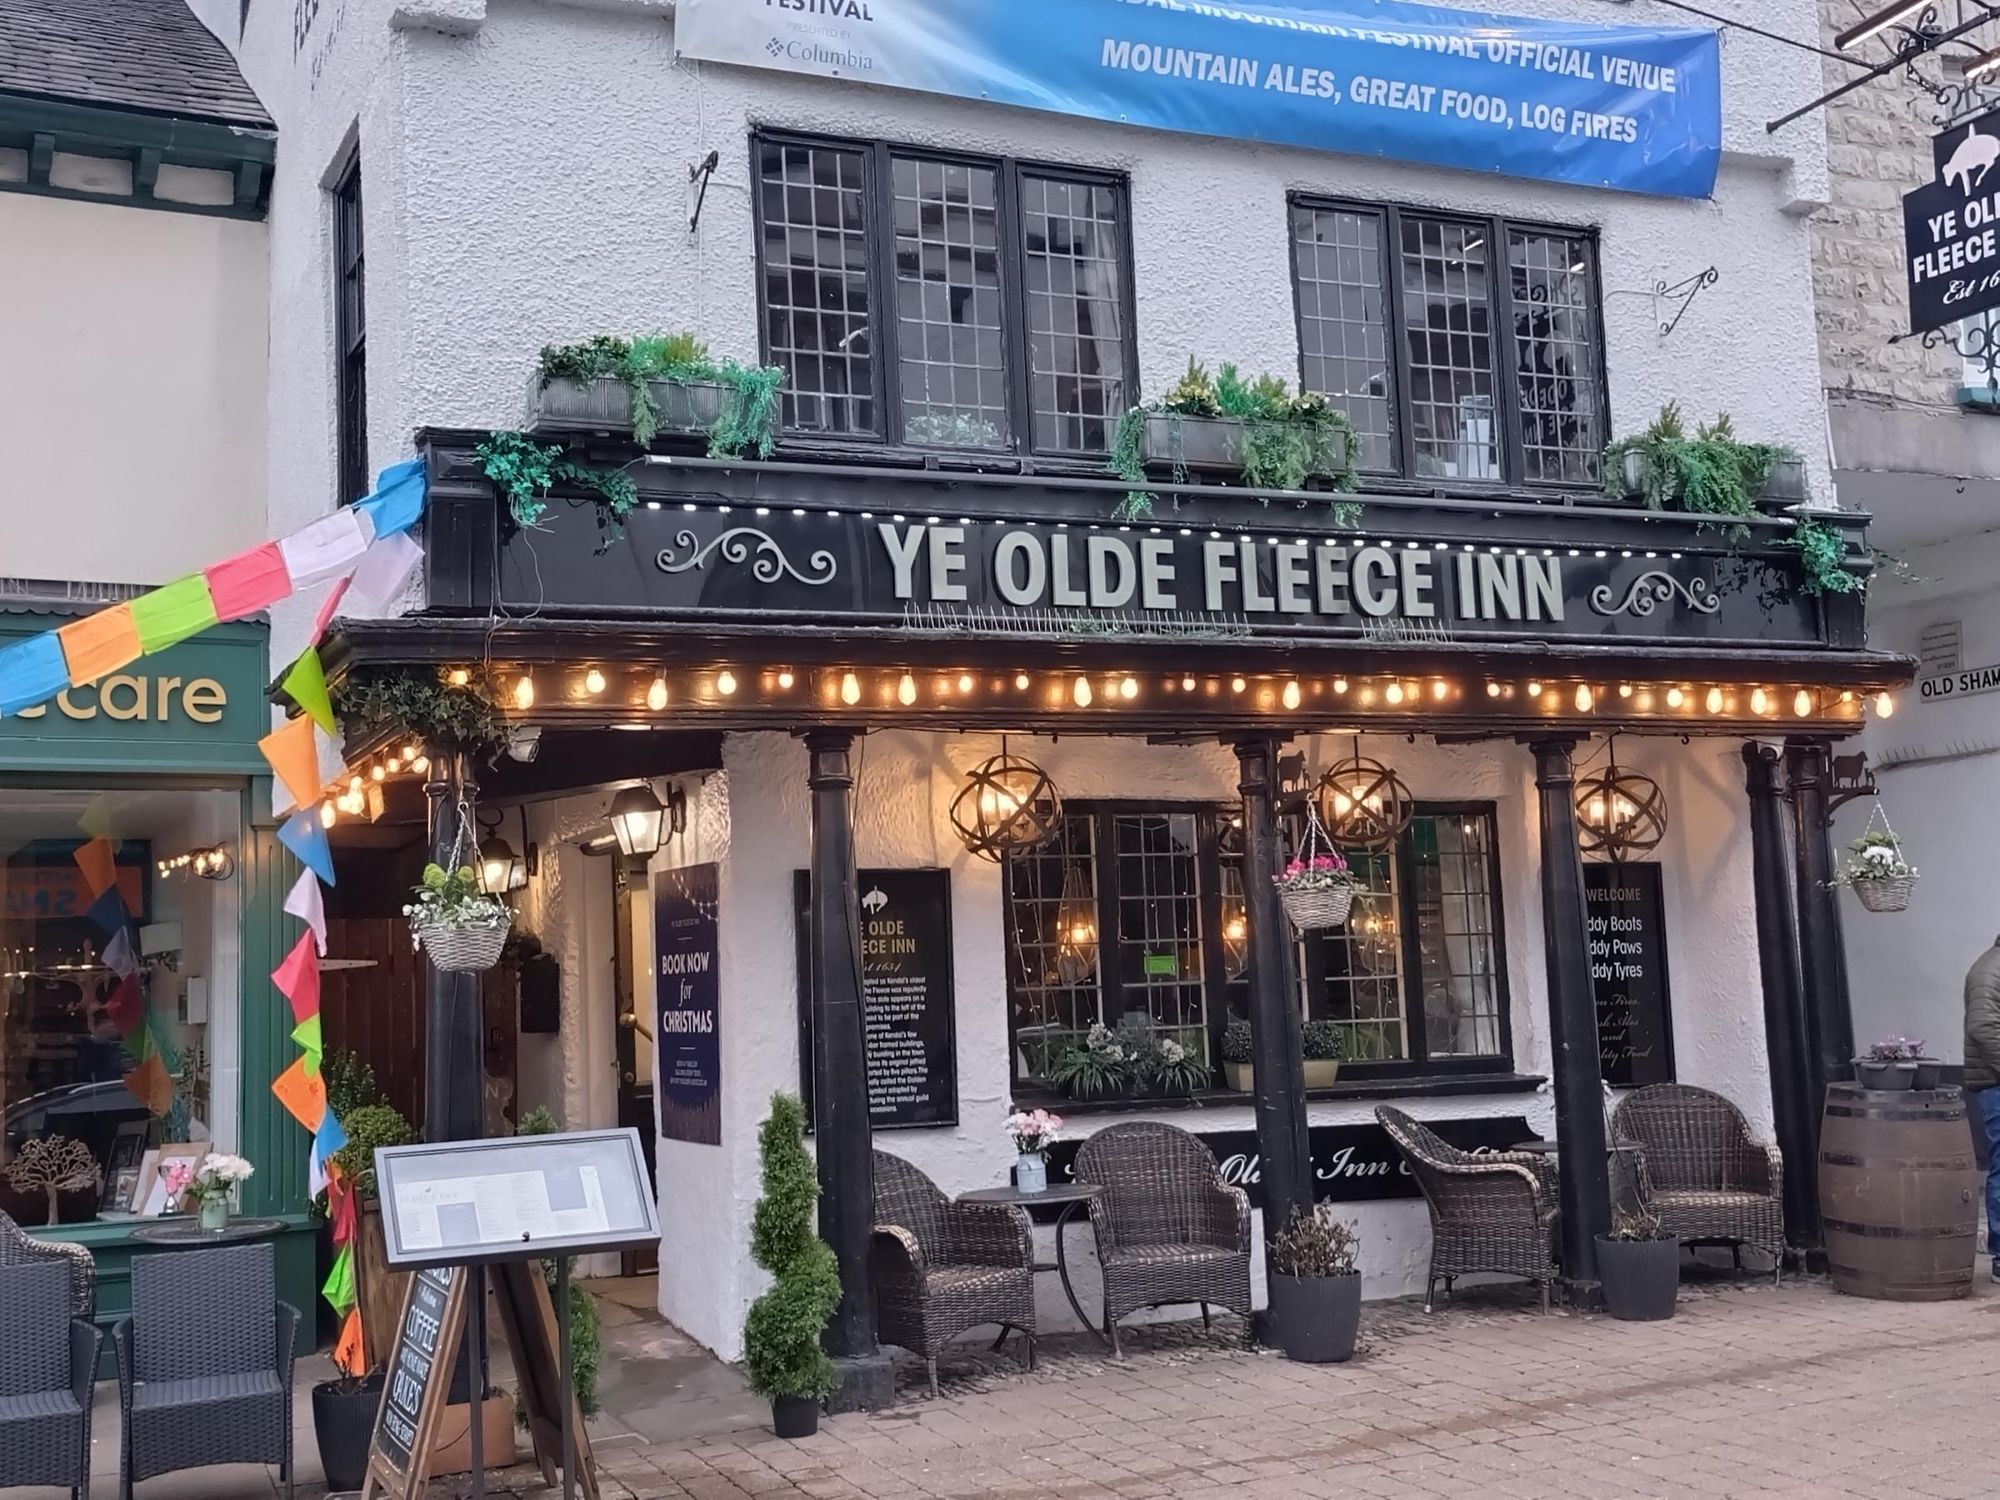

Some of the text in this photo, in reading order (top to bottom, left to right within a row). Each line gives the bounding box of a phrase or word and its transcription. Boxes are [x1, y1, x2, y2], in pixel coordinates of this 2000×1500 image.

[786, 40, 873, 69] Columbia
[1488, 38, 1595, 80] OFFICIAL
[1601, 55, 1676, 93] VENUE
[1101, 38, 1638, 144] MOUNTAIN ALES, GREAT FOOD, LOG FIRES
[1927, 210, 1957, 243] YE
[1913, 229, 1996, 283] FLEECE
[1943, 278, 1976, 305] Est
[878, 523, 1564, 622] YE OLDE FLEECE INN
[1921, 677, 1953, 697] OLD
[1586, 887, 1641, 902] WELCOME
[868, 920, 904, 936] OLDE
[1588, 915, 1642, 935] ddy Boots
[891, 938, 916, 954] INN
[1590, 938, 1642, 959] ddy Paws
[662, 951, 710, 975] BOOK NOW
[1592, 962, 1643, 982] ddy Tyres
[678, 978, 693, 1007] for
[663, 1009, 713, 1033] CHRISTMAS
[1317, 1146, 1391, 1180] Inn
[406, 1304, 440, 1352] COFFEE
[393, 1369, 422, 1416] CAKES
